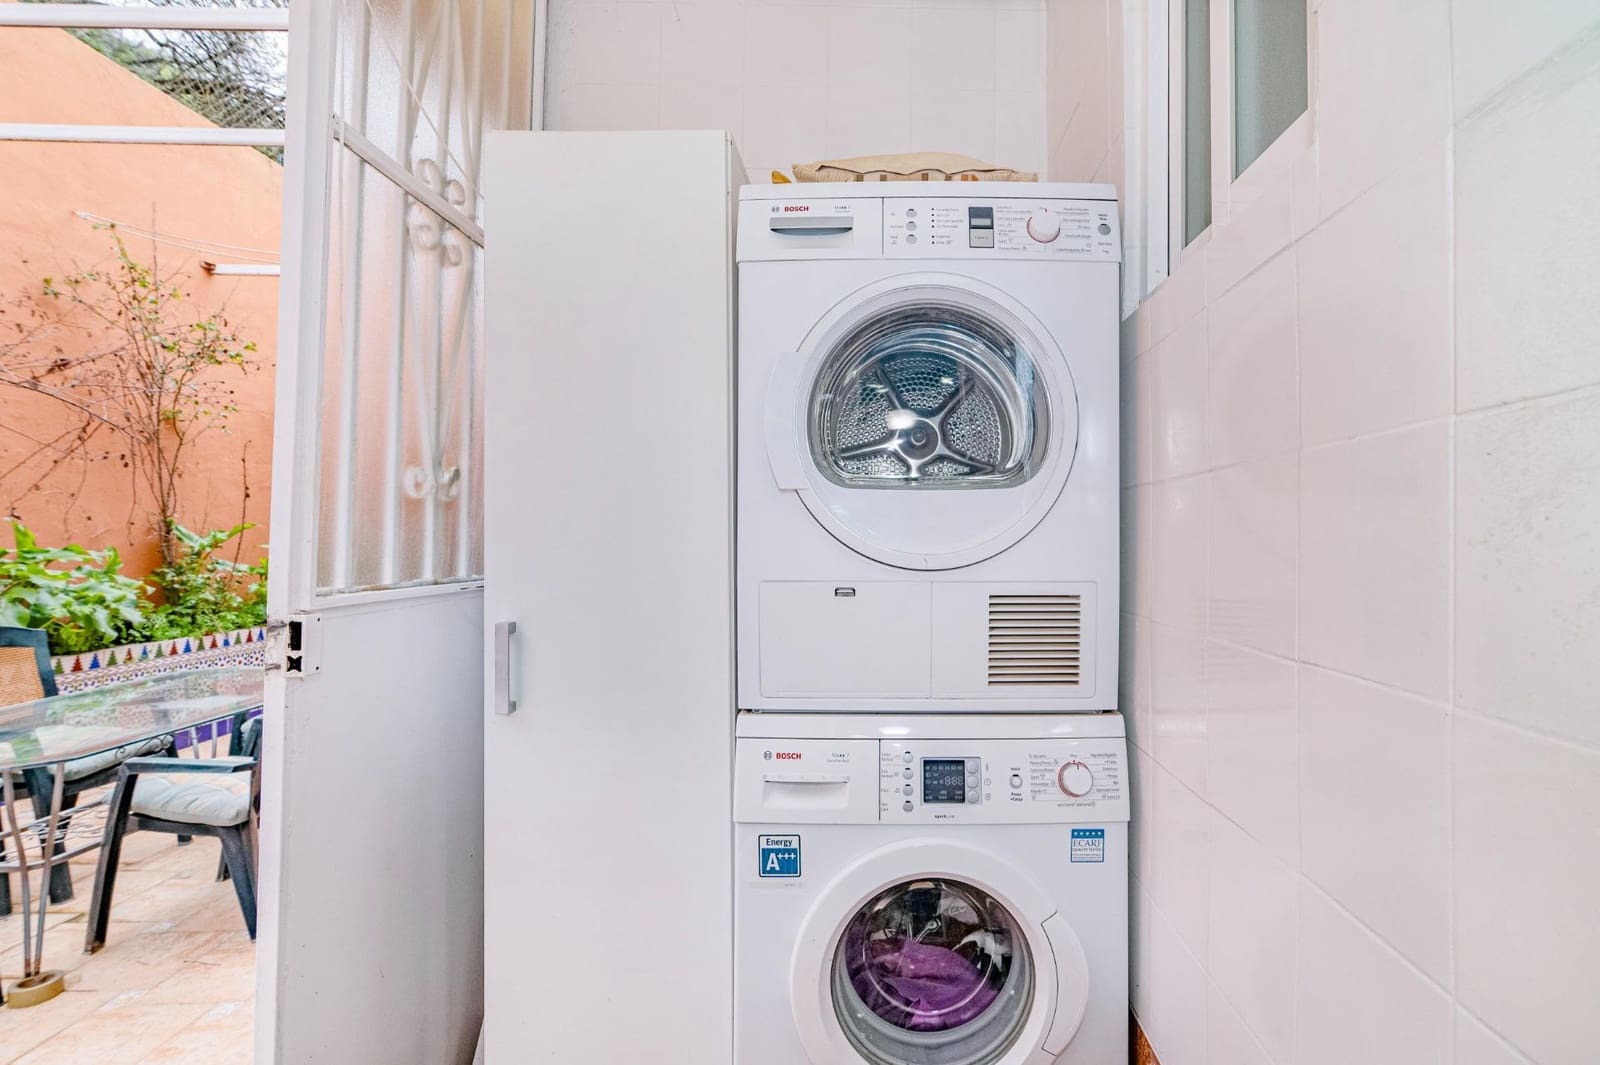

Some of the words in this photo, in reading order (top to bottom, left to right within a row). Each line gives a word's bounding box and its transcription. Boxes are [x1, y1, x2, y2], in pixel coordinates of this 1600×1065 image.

[776, 752, 802, 760] BOSCH
[766, 838, 793, 848] Energy
[766, 852, 797, 871] A+++
